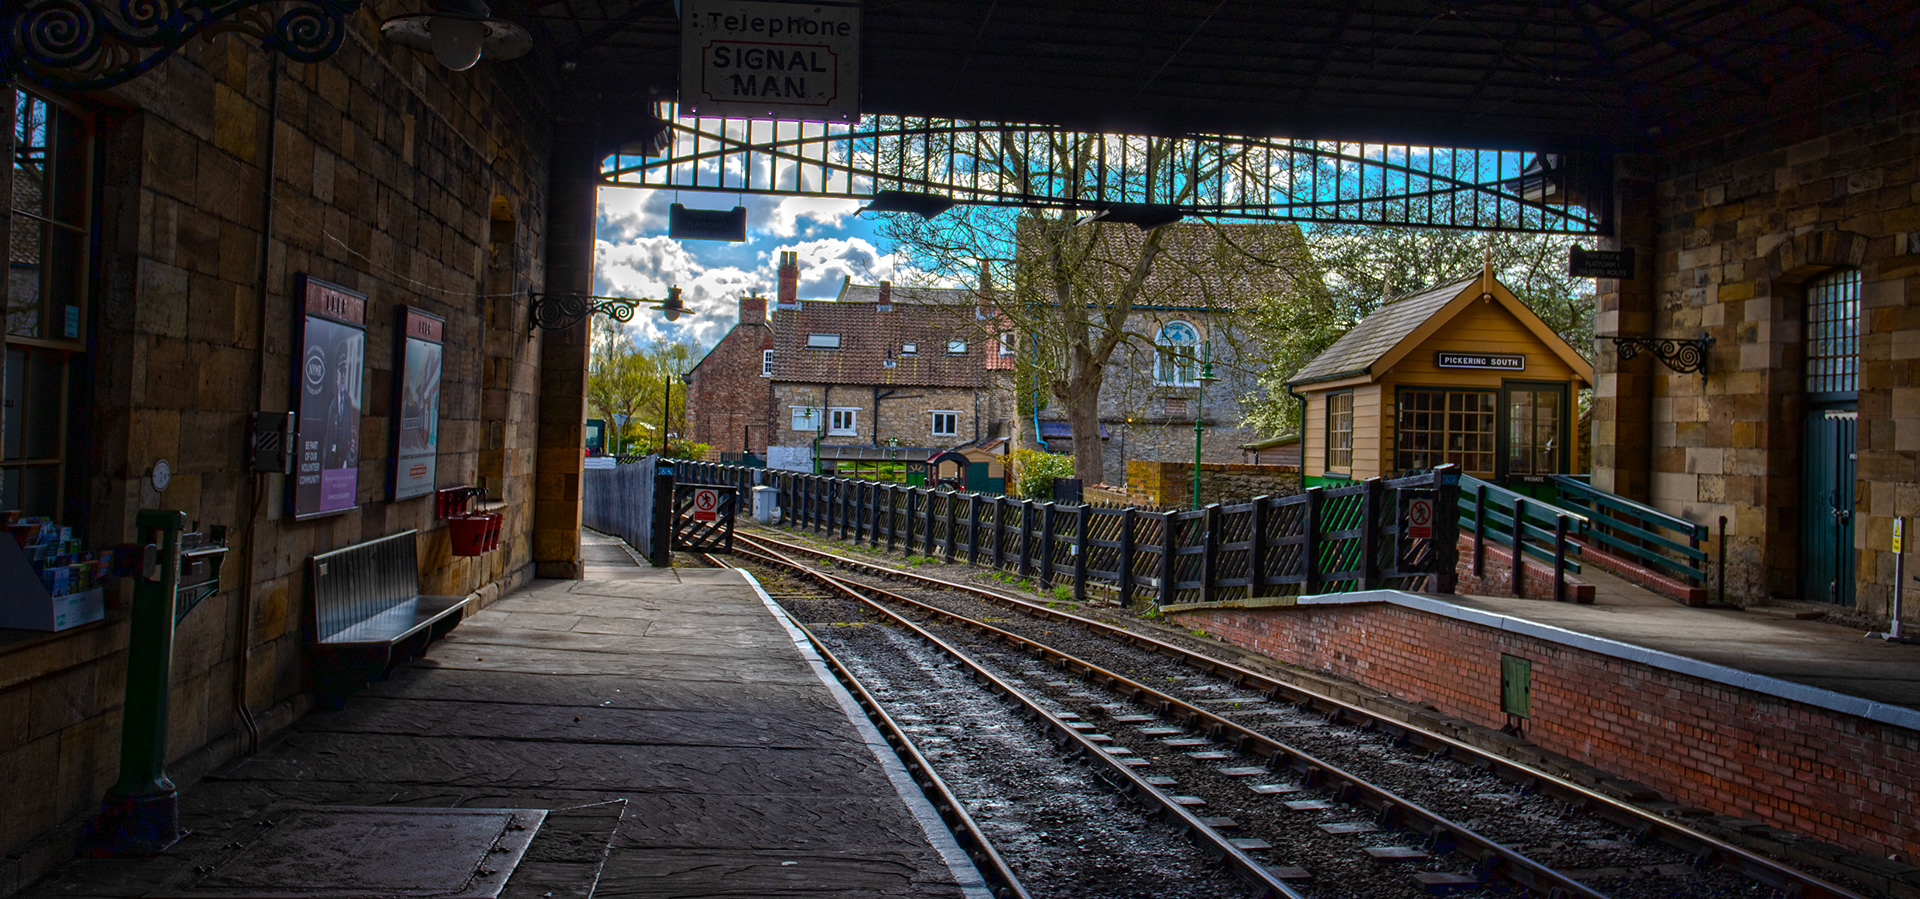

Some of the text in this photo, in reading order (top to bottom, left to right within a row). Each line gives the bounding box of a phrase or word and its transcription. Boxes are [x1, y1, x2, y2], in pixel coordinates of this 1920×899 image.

[707, 11, 851, 37] Telephone
[712, 46, 827, 73] SIGNAL
[732, 74, 805, 99] MAN
[1585, 260, 1616, 268] PLATFORM
[1444, 356, 1518, 367] PICKERING SOUTH
[308, 363, 322, 376] NYMR
[304, 452, 310, 461] OF
[301, 462, 320, 472] VOLUNTEER
[299, 474, 320, 486] COMMUNITY
